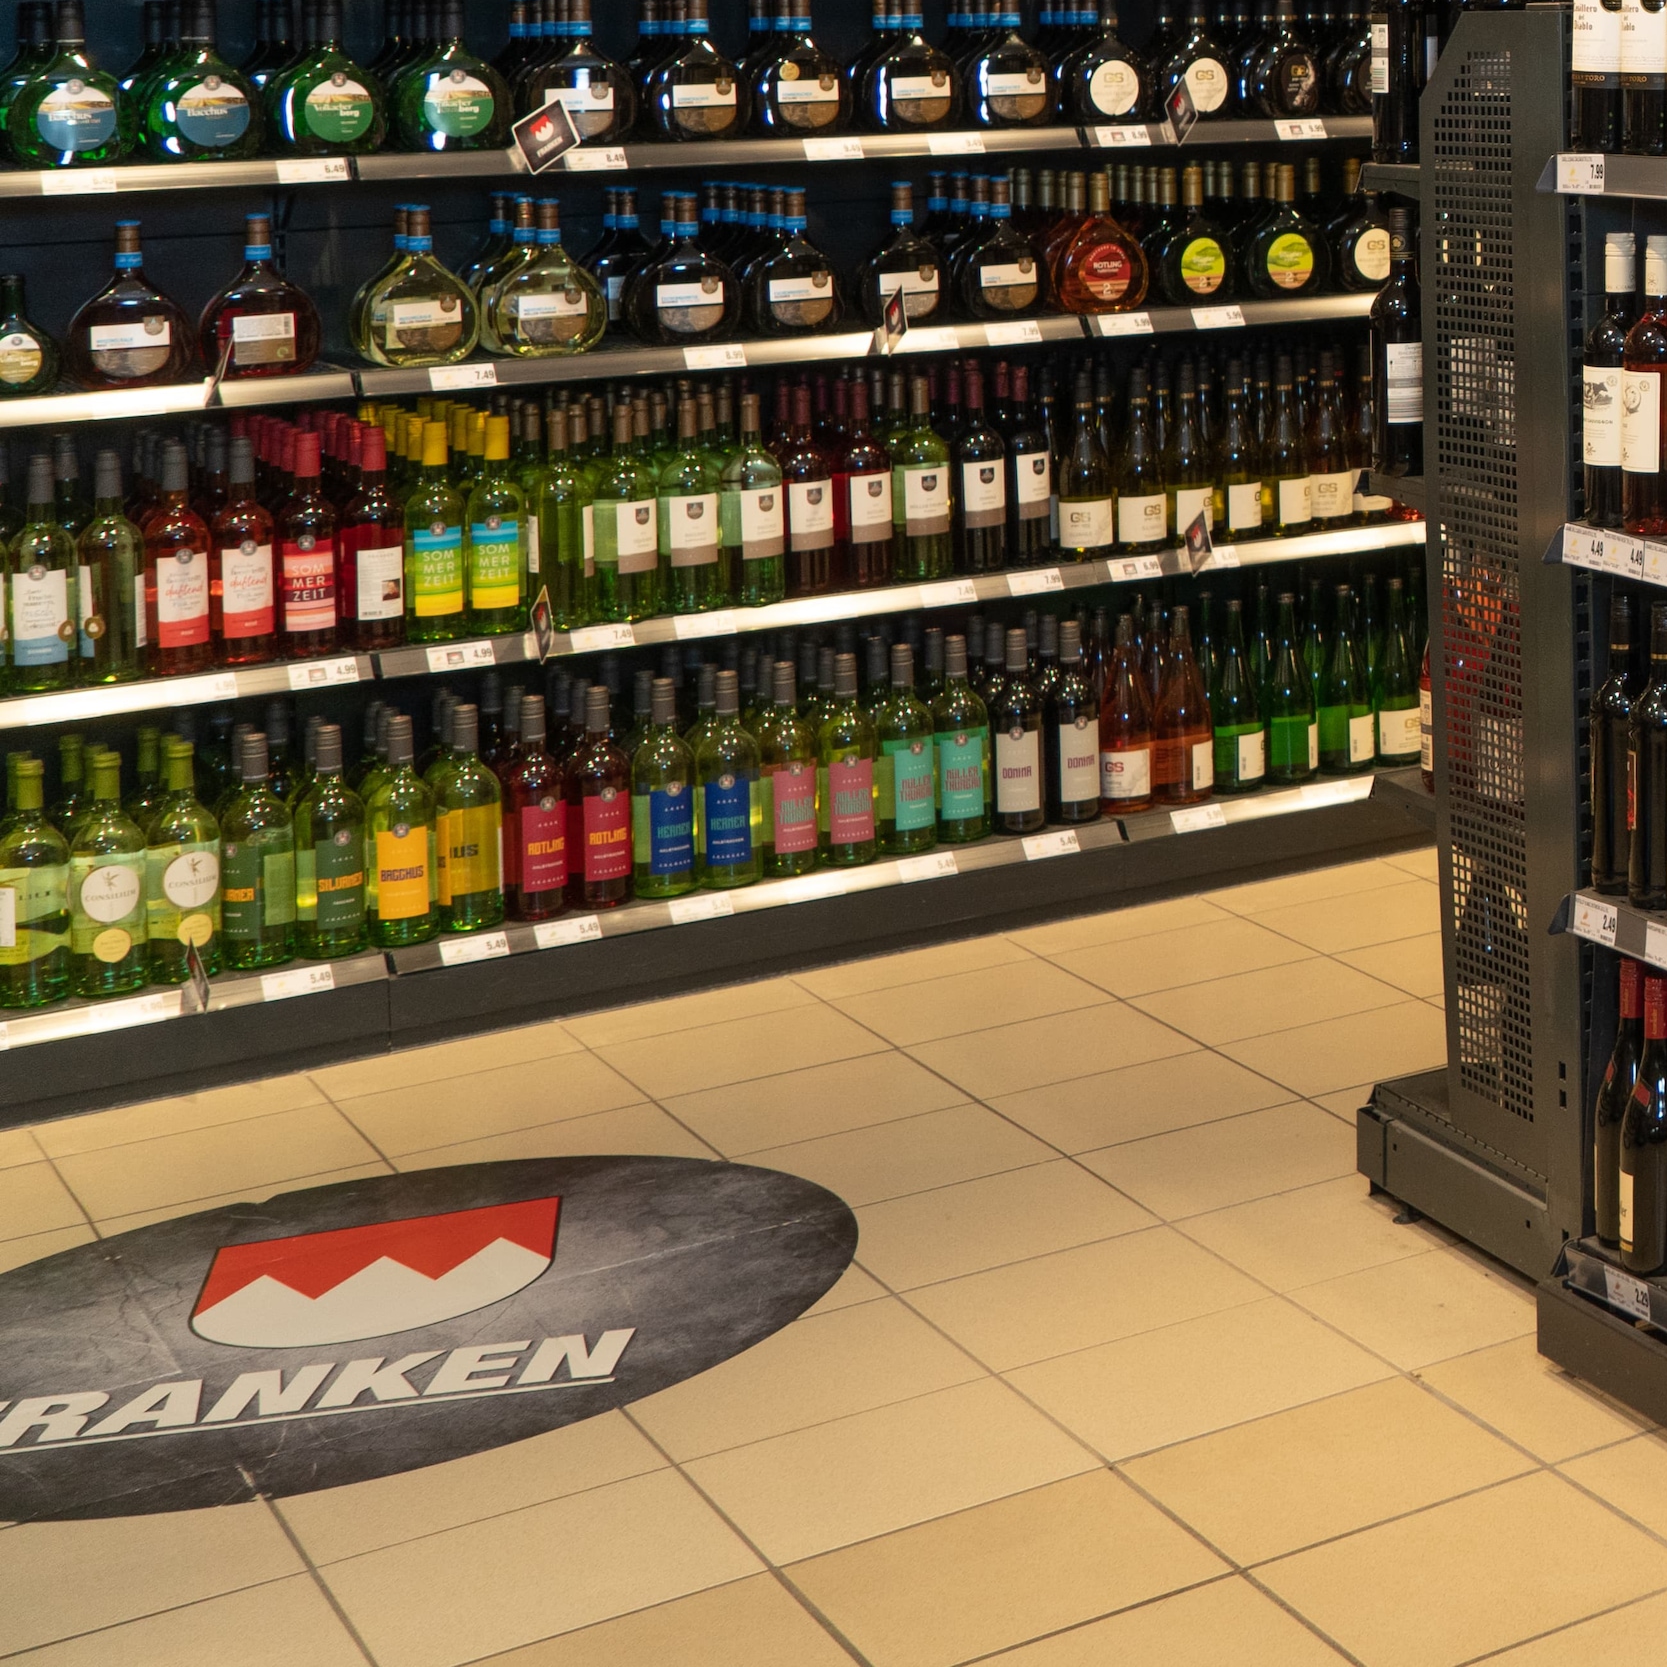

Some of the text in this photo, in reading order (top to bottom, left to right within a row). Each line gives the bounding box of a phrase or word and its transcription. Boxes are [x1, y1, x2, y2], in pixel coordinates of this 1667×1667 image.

[1590, 165, 1604, 180] 7.99
[422, 549, 454, 562] SOM
[479, 543, 510, 555] SOM
[479, 554, 510, 567] MER
[1630, 548, 1643, 566] 4.49
[291, 562, 325, 575] SOM
[423, 561, 455, 574] MER
[480, 566, 510, 580] ZEIT
[290, 575, 325, 588] MER
[424, 573, 455, 587] ZEIT
[292, 588, 327, 602] ZEIT
[589, 827, 627, 845] ROTLING
[1602, 914, 1616, 933] 2.49
